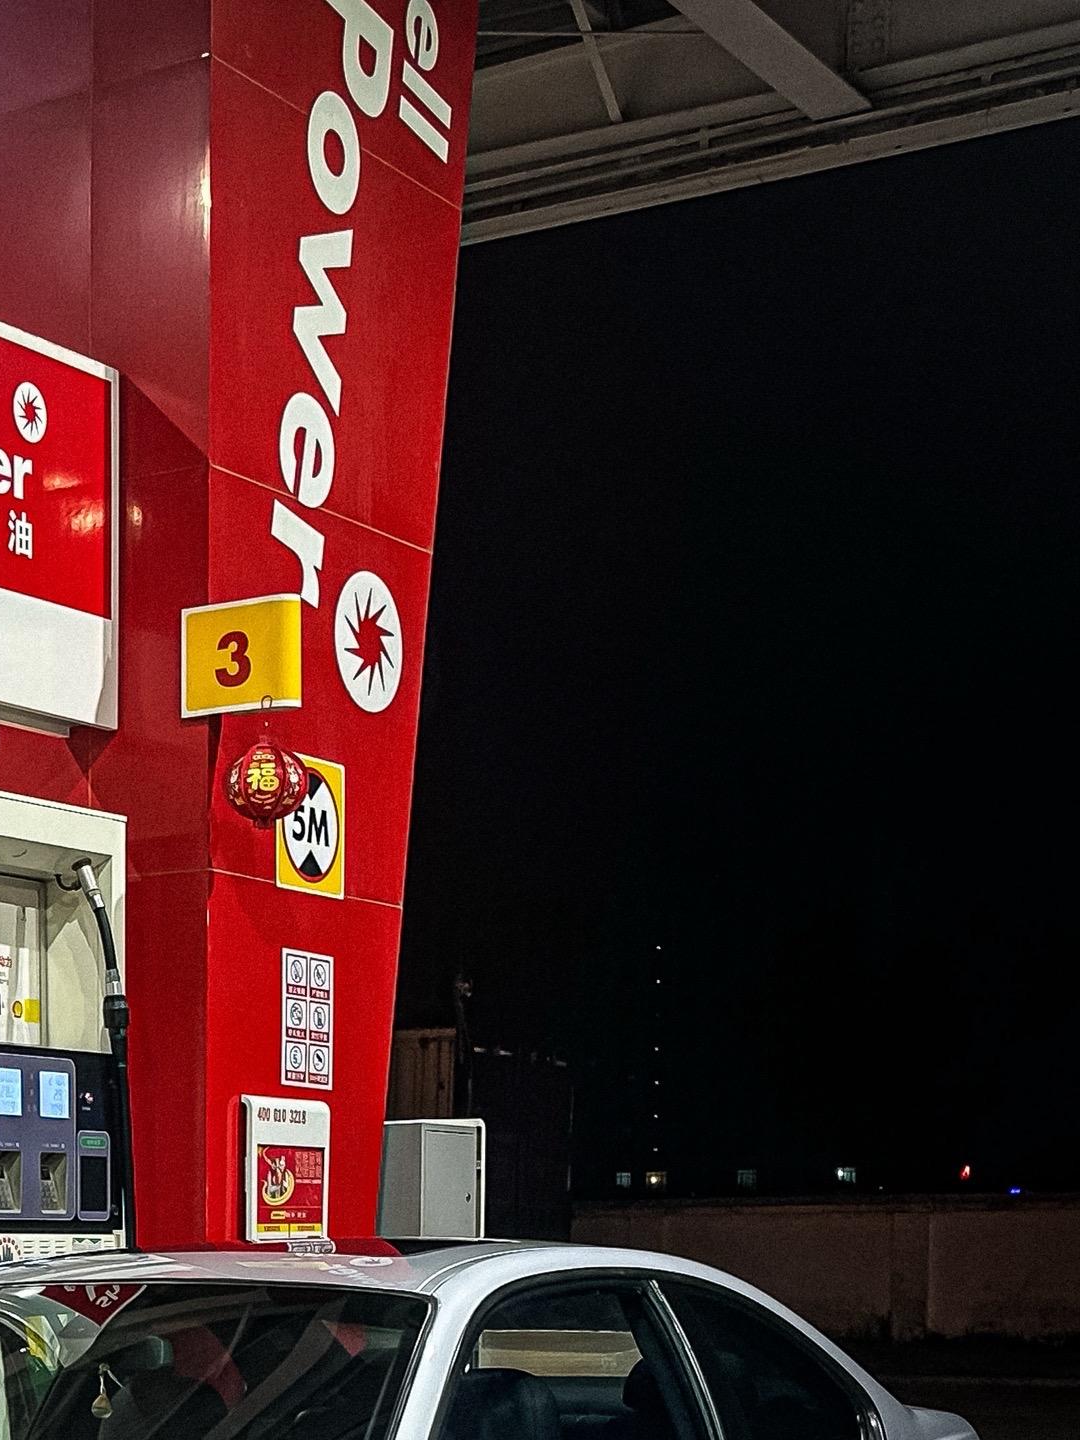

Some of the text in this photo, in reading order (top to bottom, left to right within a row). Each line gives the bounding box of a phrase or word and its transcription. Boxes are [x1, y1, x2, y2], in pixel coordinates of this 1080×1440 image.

[216, 631, 252, 686] 3
[247, 762, 280, 793] 福
[292, 805, 330, 847] 5M
